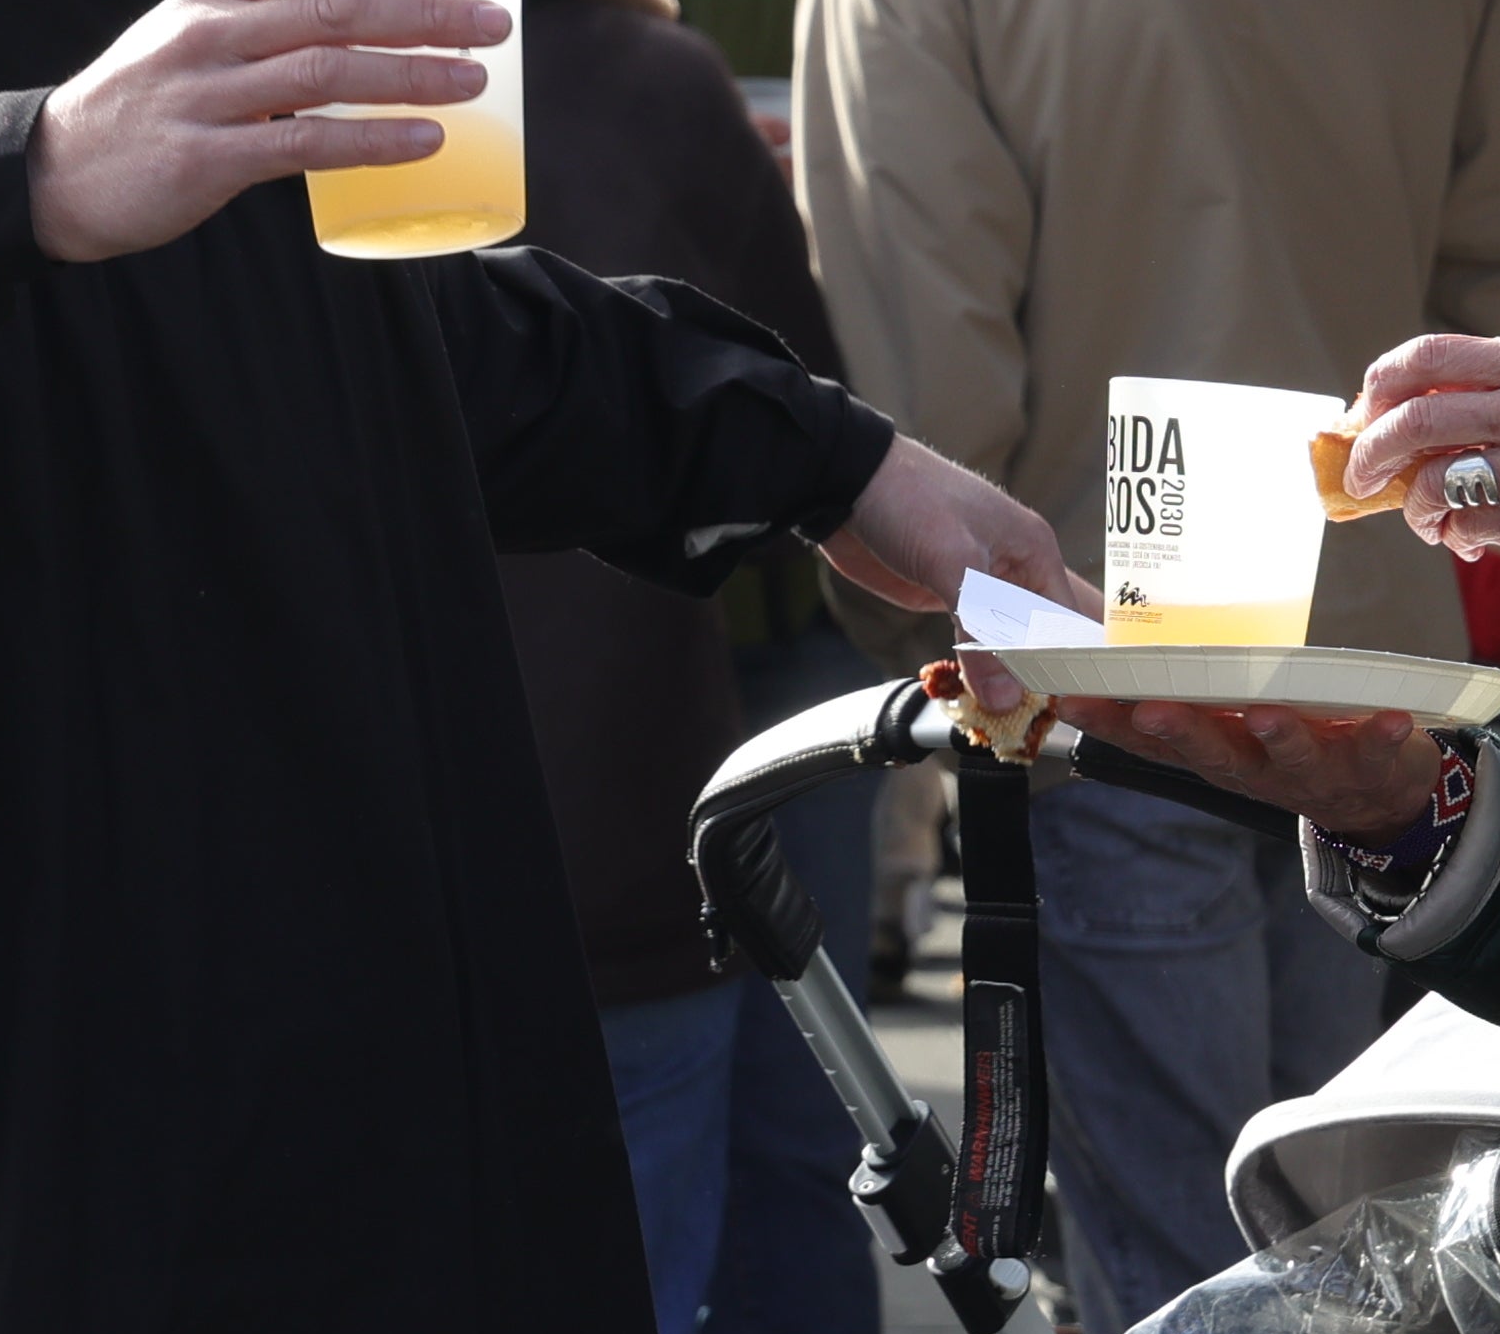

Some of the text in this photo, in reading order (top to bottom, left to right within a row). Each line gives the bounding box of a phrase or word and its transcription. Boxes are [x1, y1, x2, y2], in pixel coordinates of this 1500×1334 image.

[1108, 415, 1185, 475] BIDA
[1107, 476, 1156, 535] SOS
[1159, 479, 1185, 536] 2030
[967, 1051, 992, 1181] WARNHINWEIS
